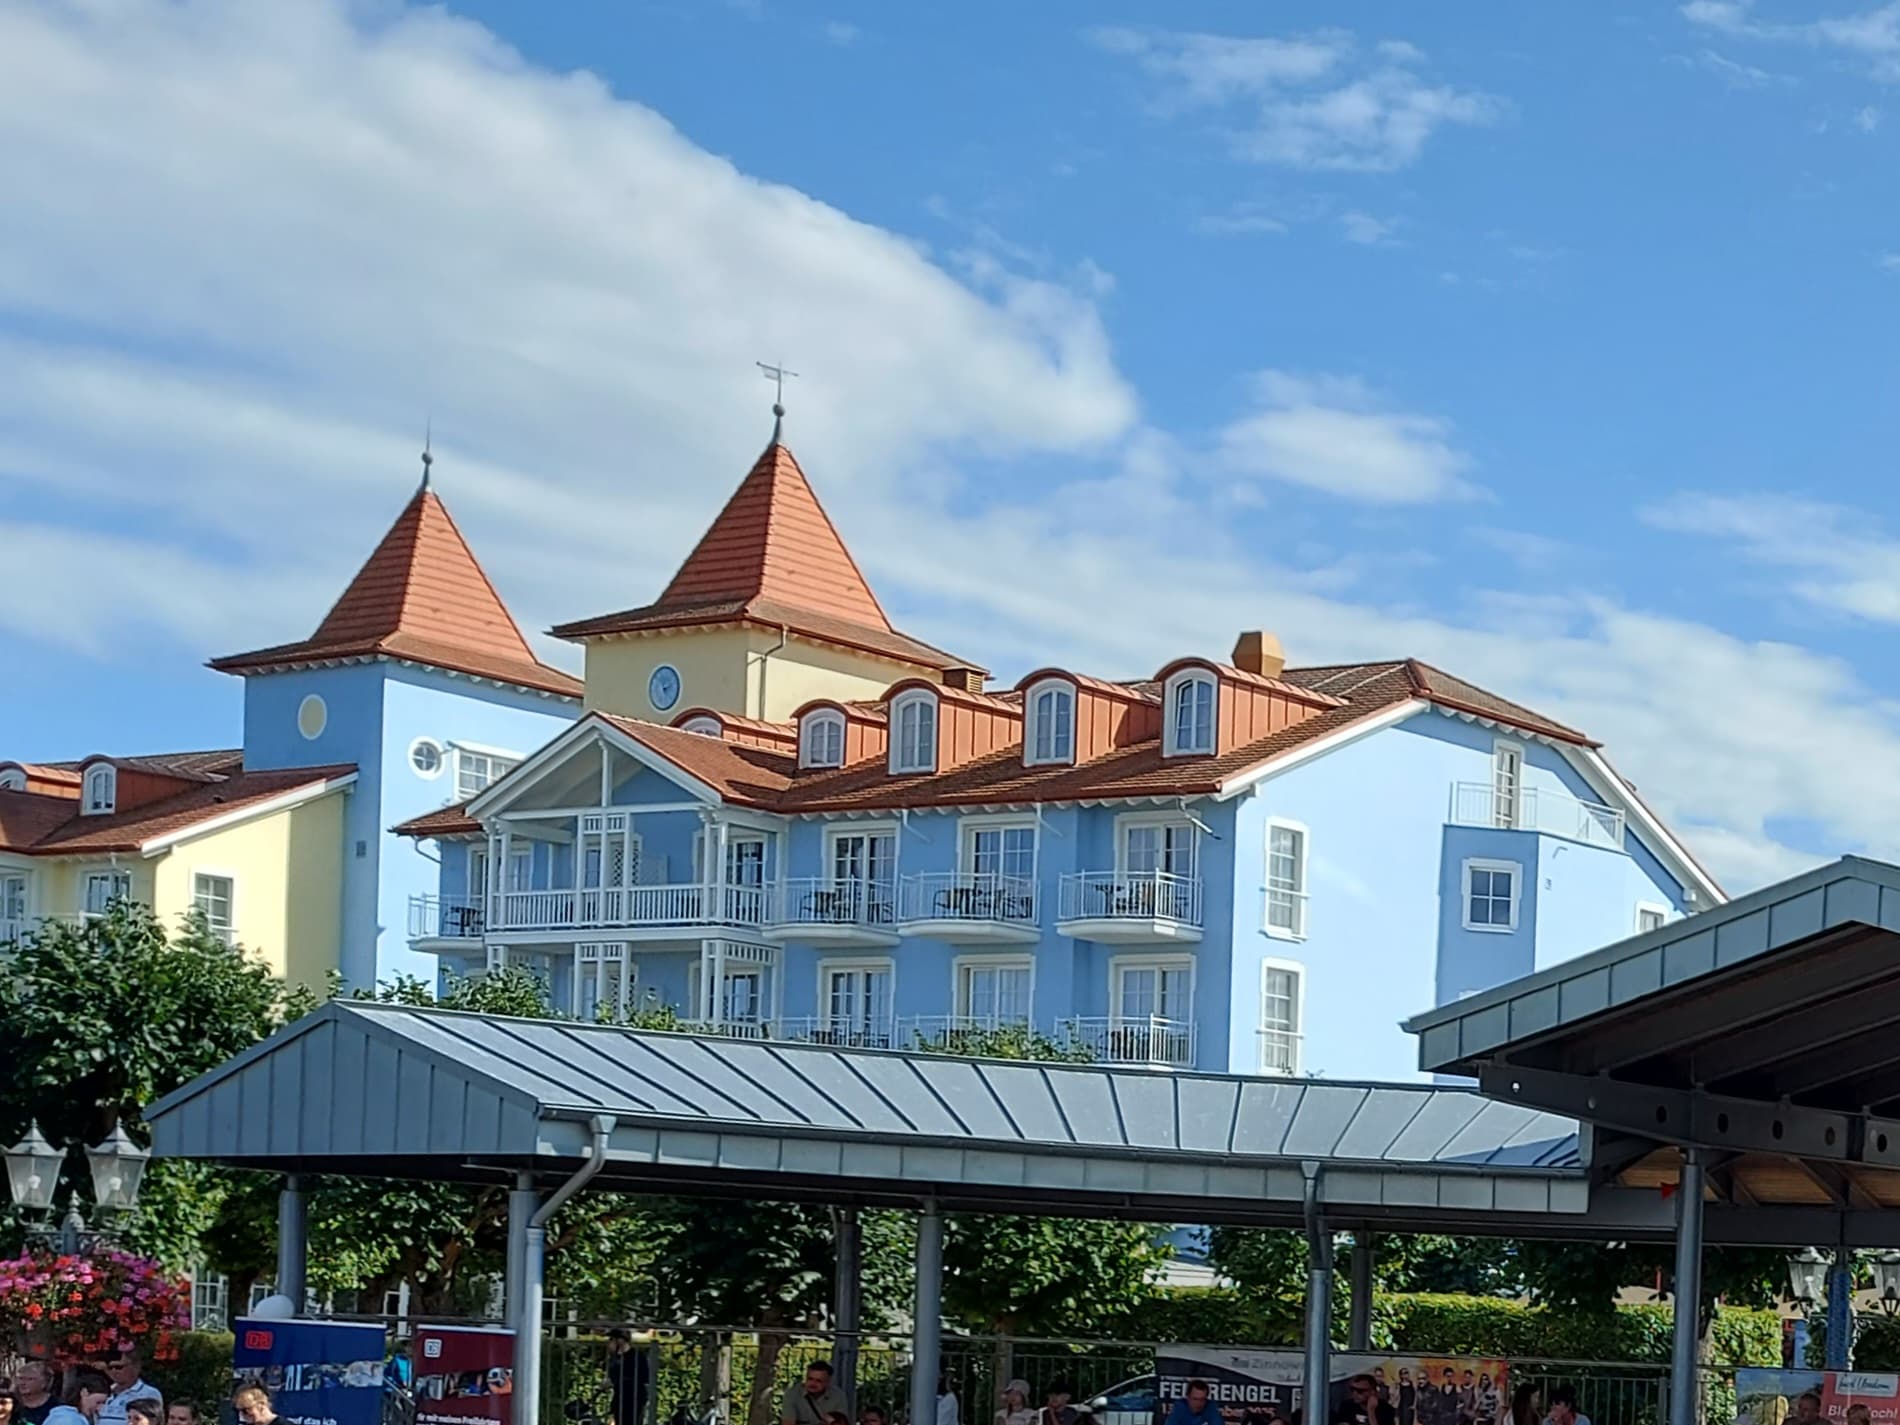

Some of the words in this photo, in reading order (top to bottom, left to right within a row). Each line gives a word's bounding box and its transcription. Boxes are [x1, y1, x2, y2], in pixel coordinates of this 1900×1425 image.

[246, 1331, 273, 1349] DB
[1159, 1381, 1281, 1404] FERENGEL
[1868, 1407, 1898, 1419] och!
[304, 1417, 321, 1425] das
